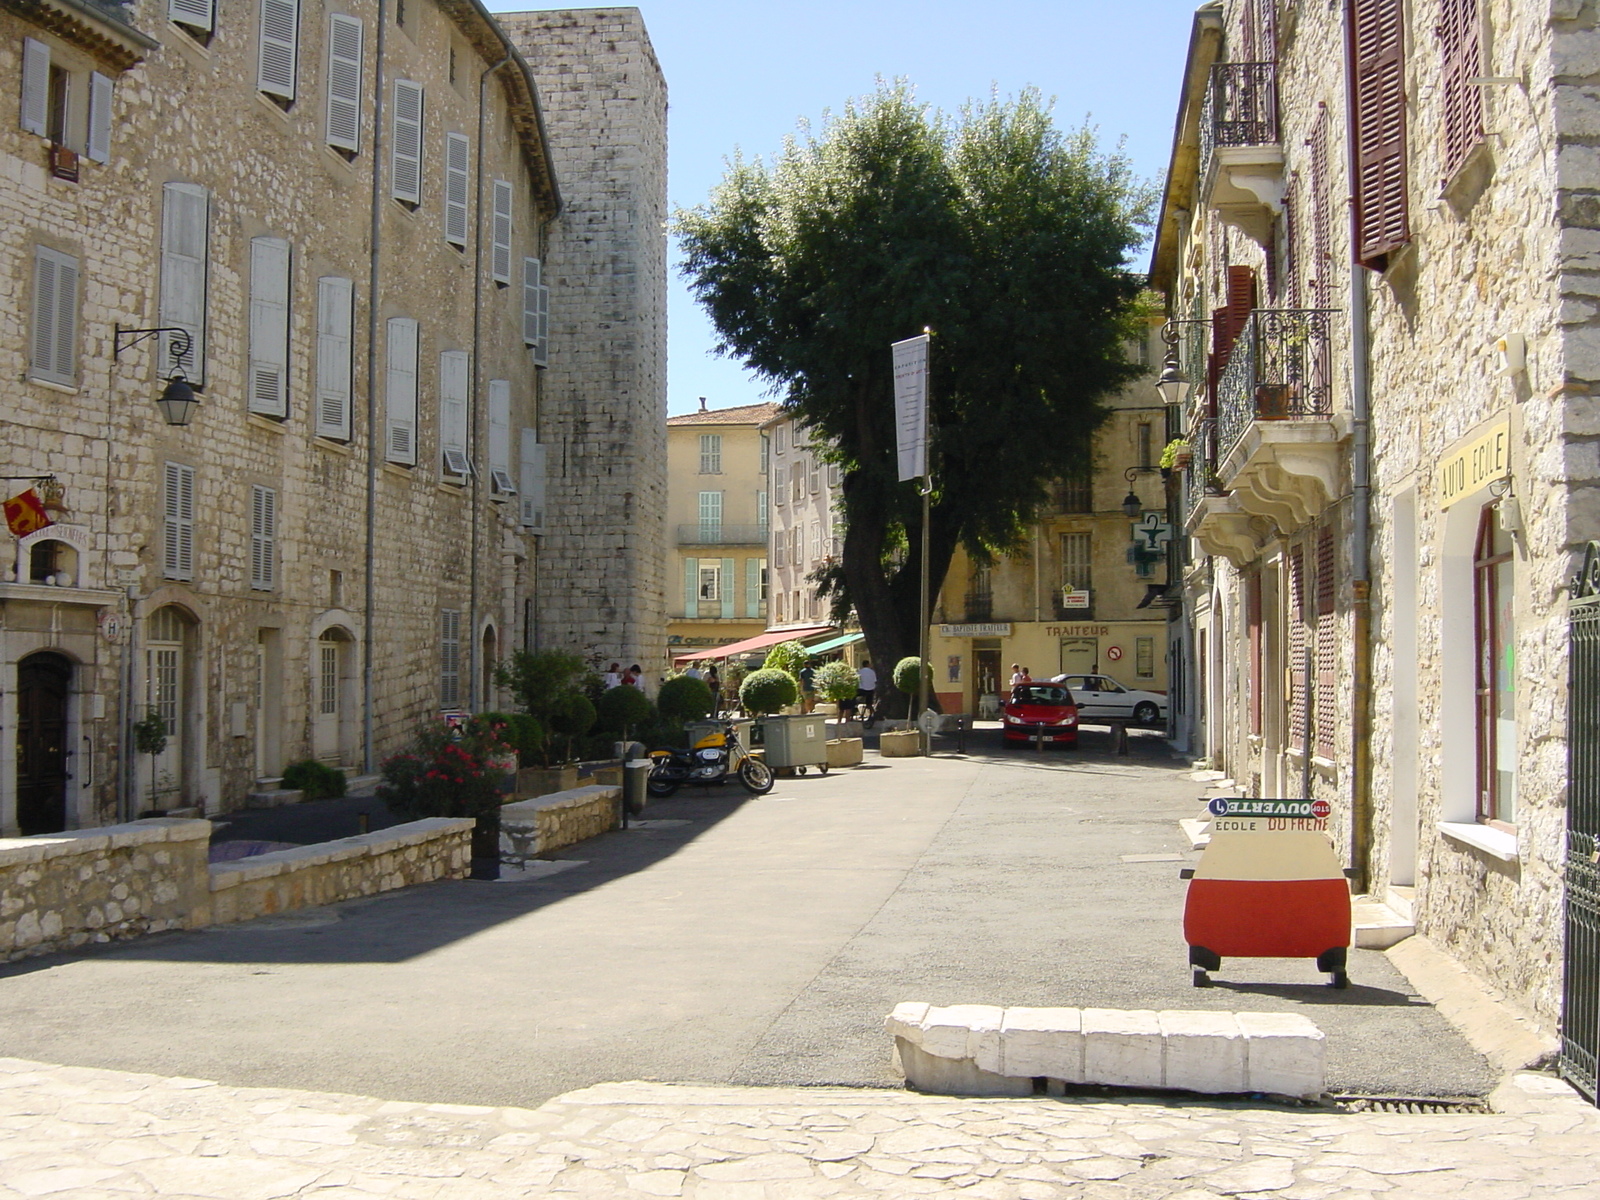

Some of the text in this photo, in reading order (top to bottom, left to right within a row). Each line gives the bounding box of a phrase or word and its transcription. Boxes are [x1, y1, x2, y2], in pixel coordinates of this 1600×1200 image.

[1443, 457, 1464, 499] AUTO
[108, 622, 116, 634] H
[1045, 626, 1109, 636] TRAITEUR
[1228, 802, 1311, 815] OUVERTE
[1216, 821, 1256, 831] ECOLE
[1268, 817, 1287, 831] DU
